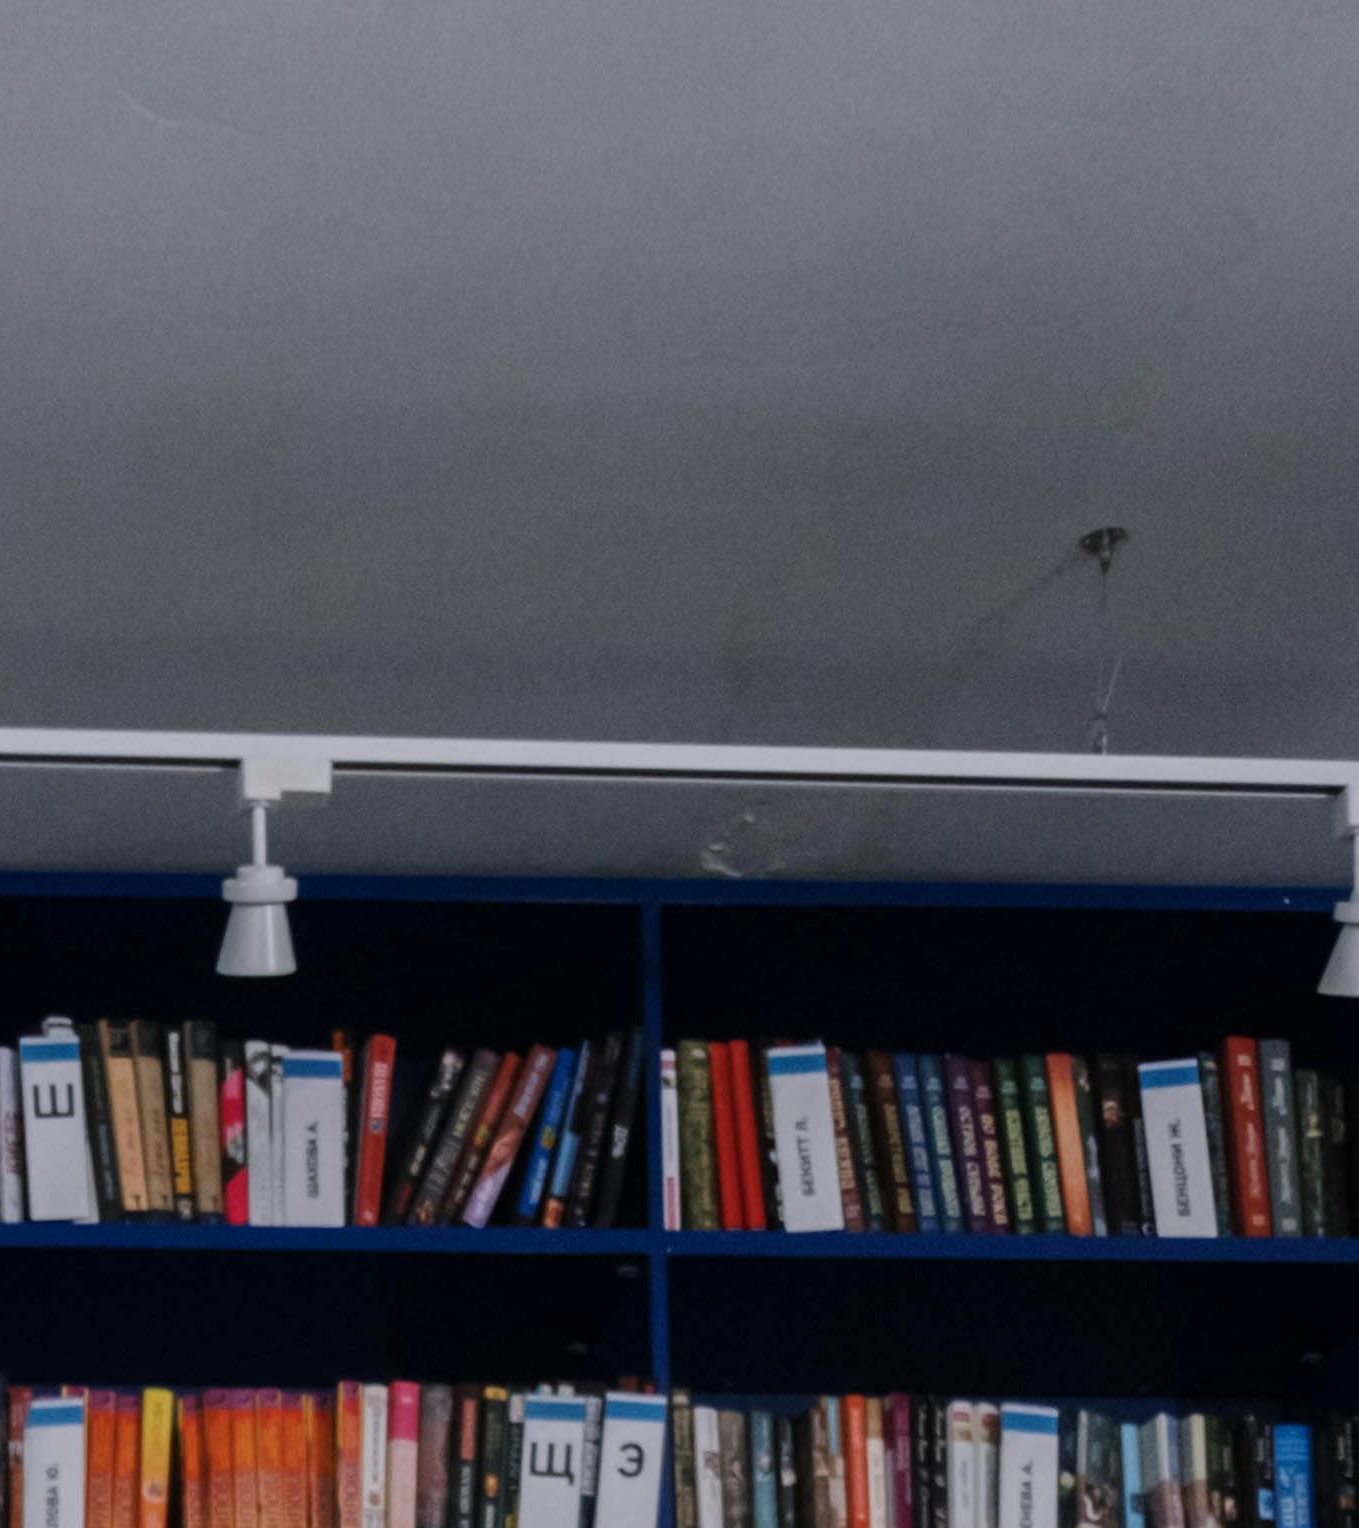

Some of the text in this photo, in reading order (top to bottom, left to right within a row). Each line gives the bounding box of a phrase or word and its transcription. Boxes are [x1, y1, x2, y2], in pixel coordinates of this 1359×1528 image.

[33, 1083, 74, 1119] Ш
[305, 1136, 320, 1200] ШАХОВА
[796, 1135, 816, 1198] БЕКИТТ
[1167, 1117, 1191, 1218] БЕНЦОНИ Ж.
[528, 1441, 575, 1484] Щ
[616, 1441, 646, 1479] Э
